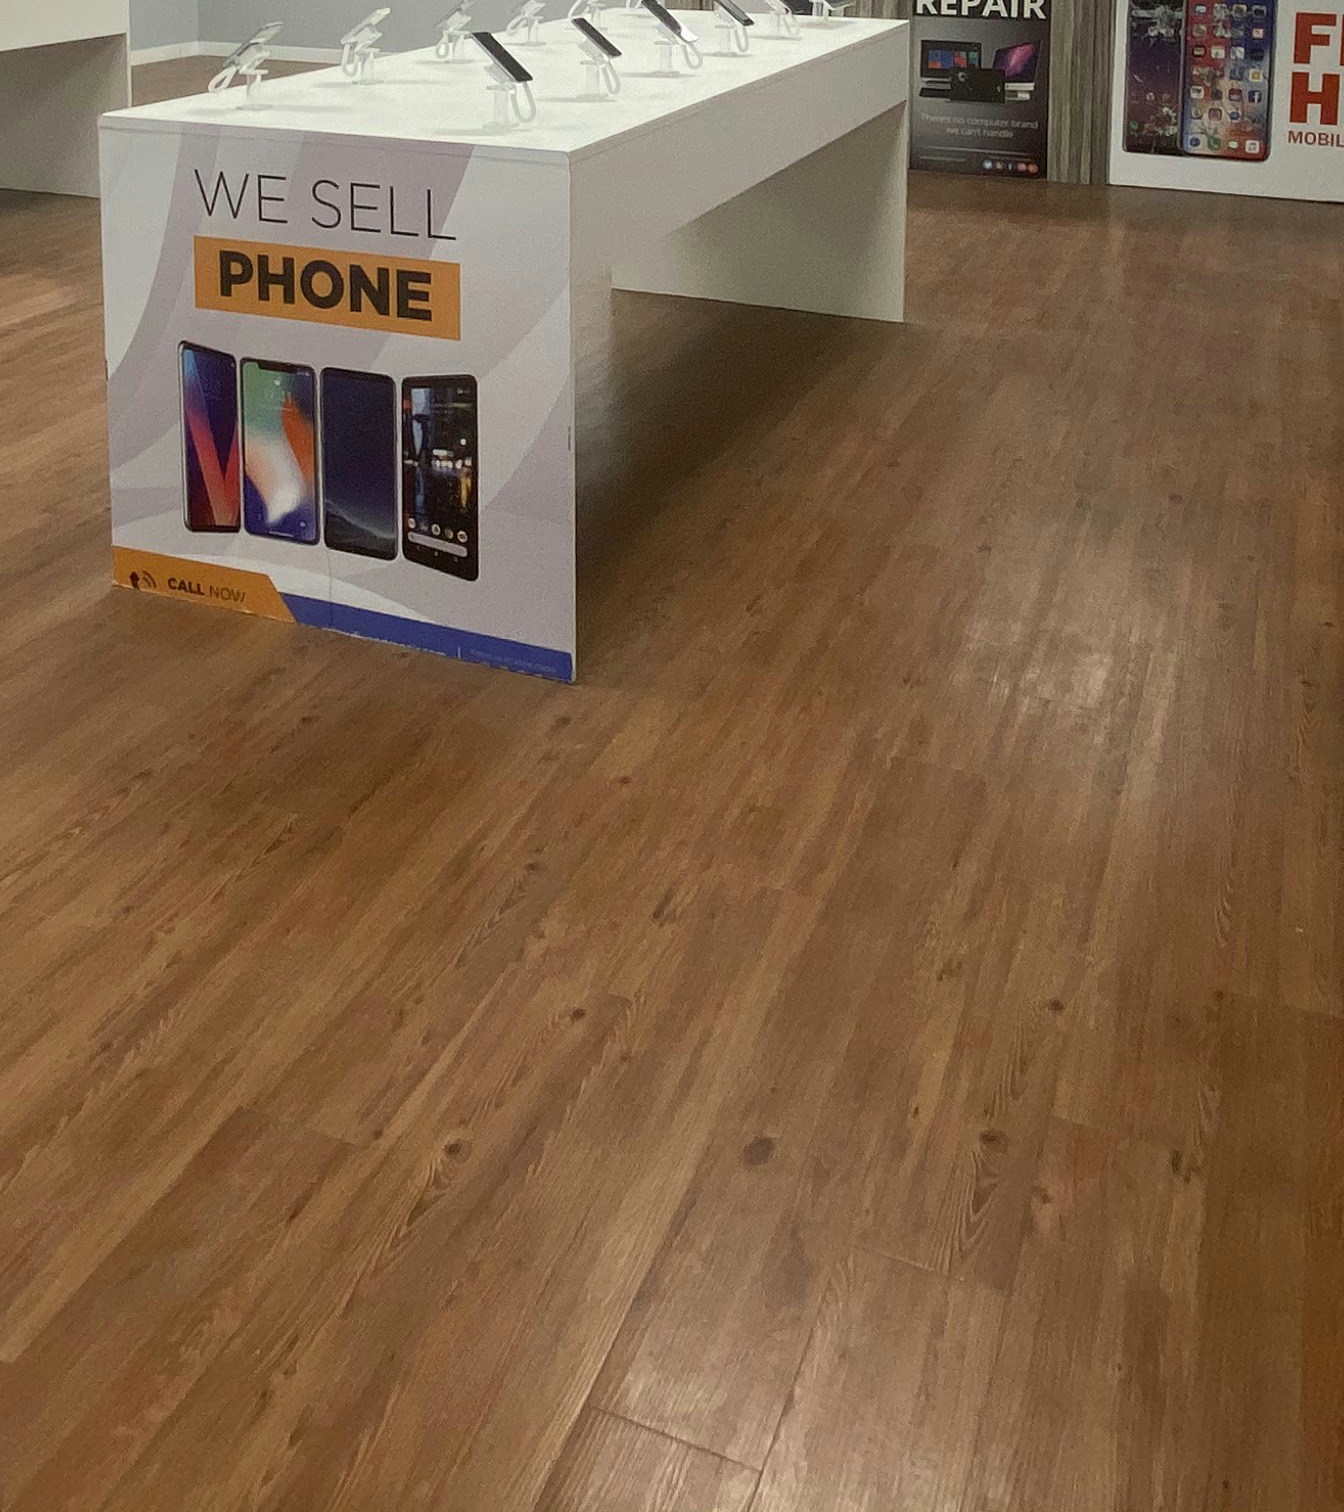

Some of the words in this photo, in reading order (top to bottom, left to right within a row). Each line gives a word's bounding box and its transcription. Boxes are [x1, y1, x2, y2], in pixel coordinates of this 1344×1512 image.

[966, 117, 1009, 129] computer
[1011, 120, 1039, 130] brand
[193, 168, 288, 224] WE
[311, 179, 457, 241] SELL
[219, 249, 433, 322] PHONE
[167, 577, 205, 596] CALL
[207, 584, 247, 604] NOW
